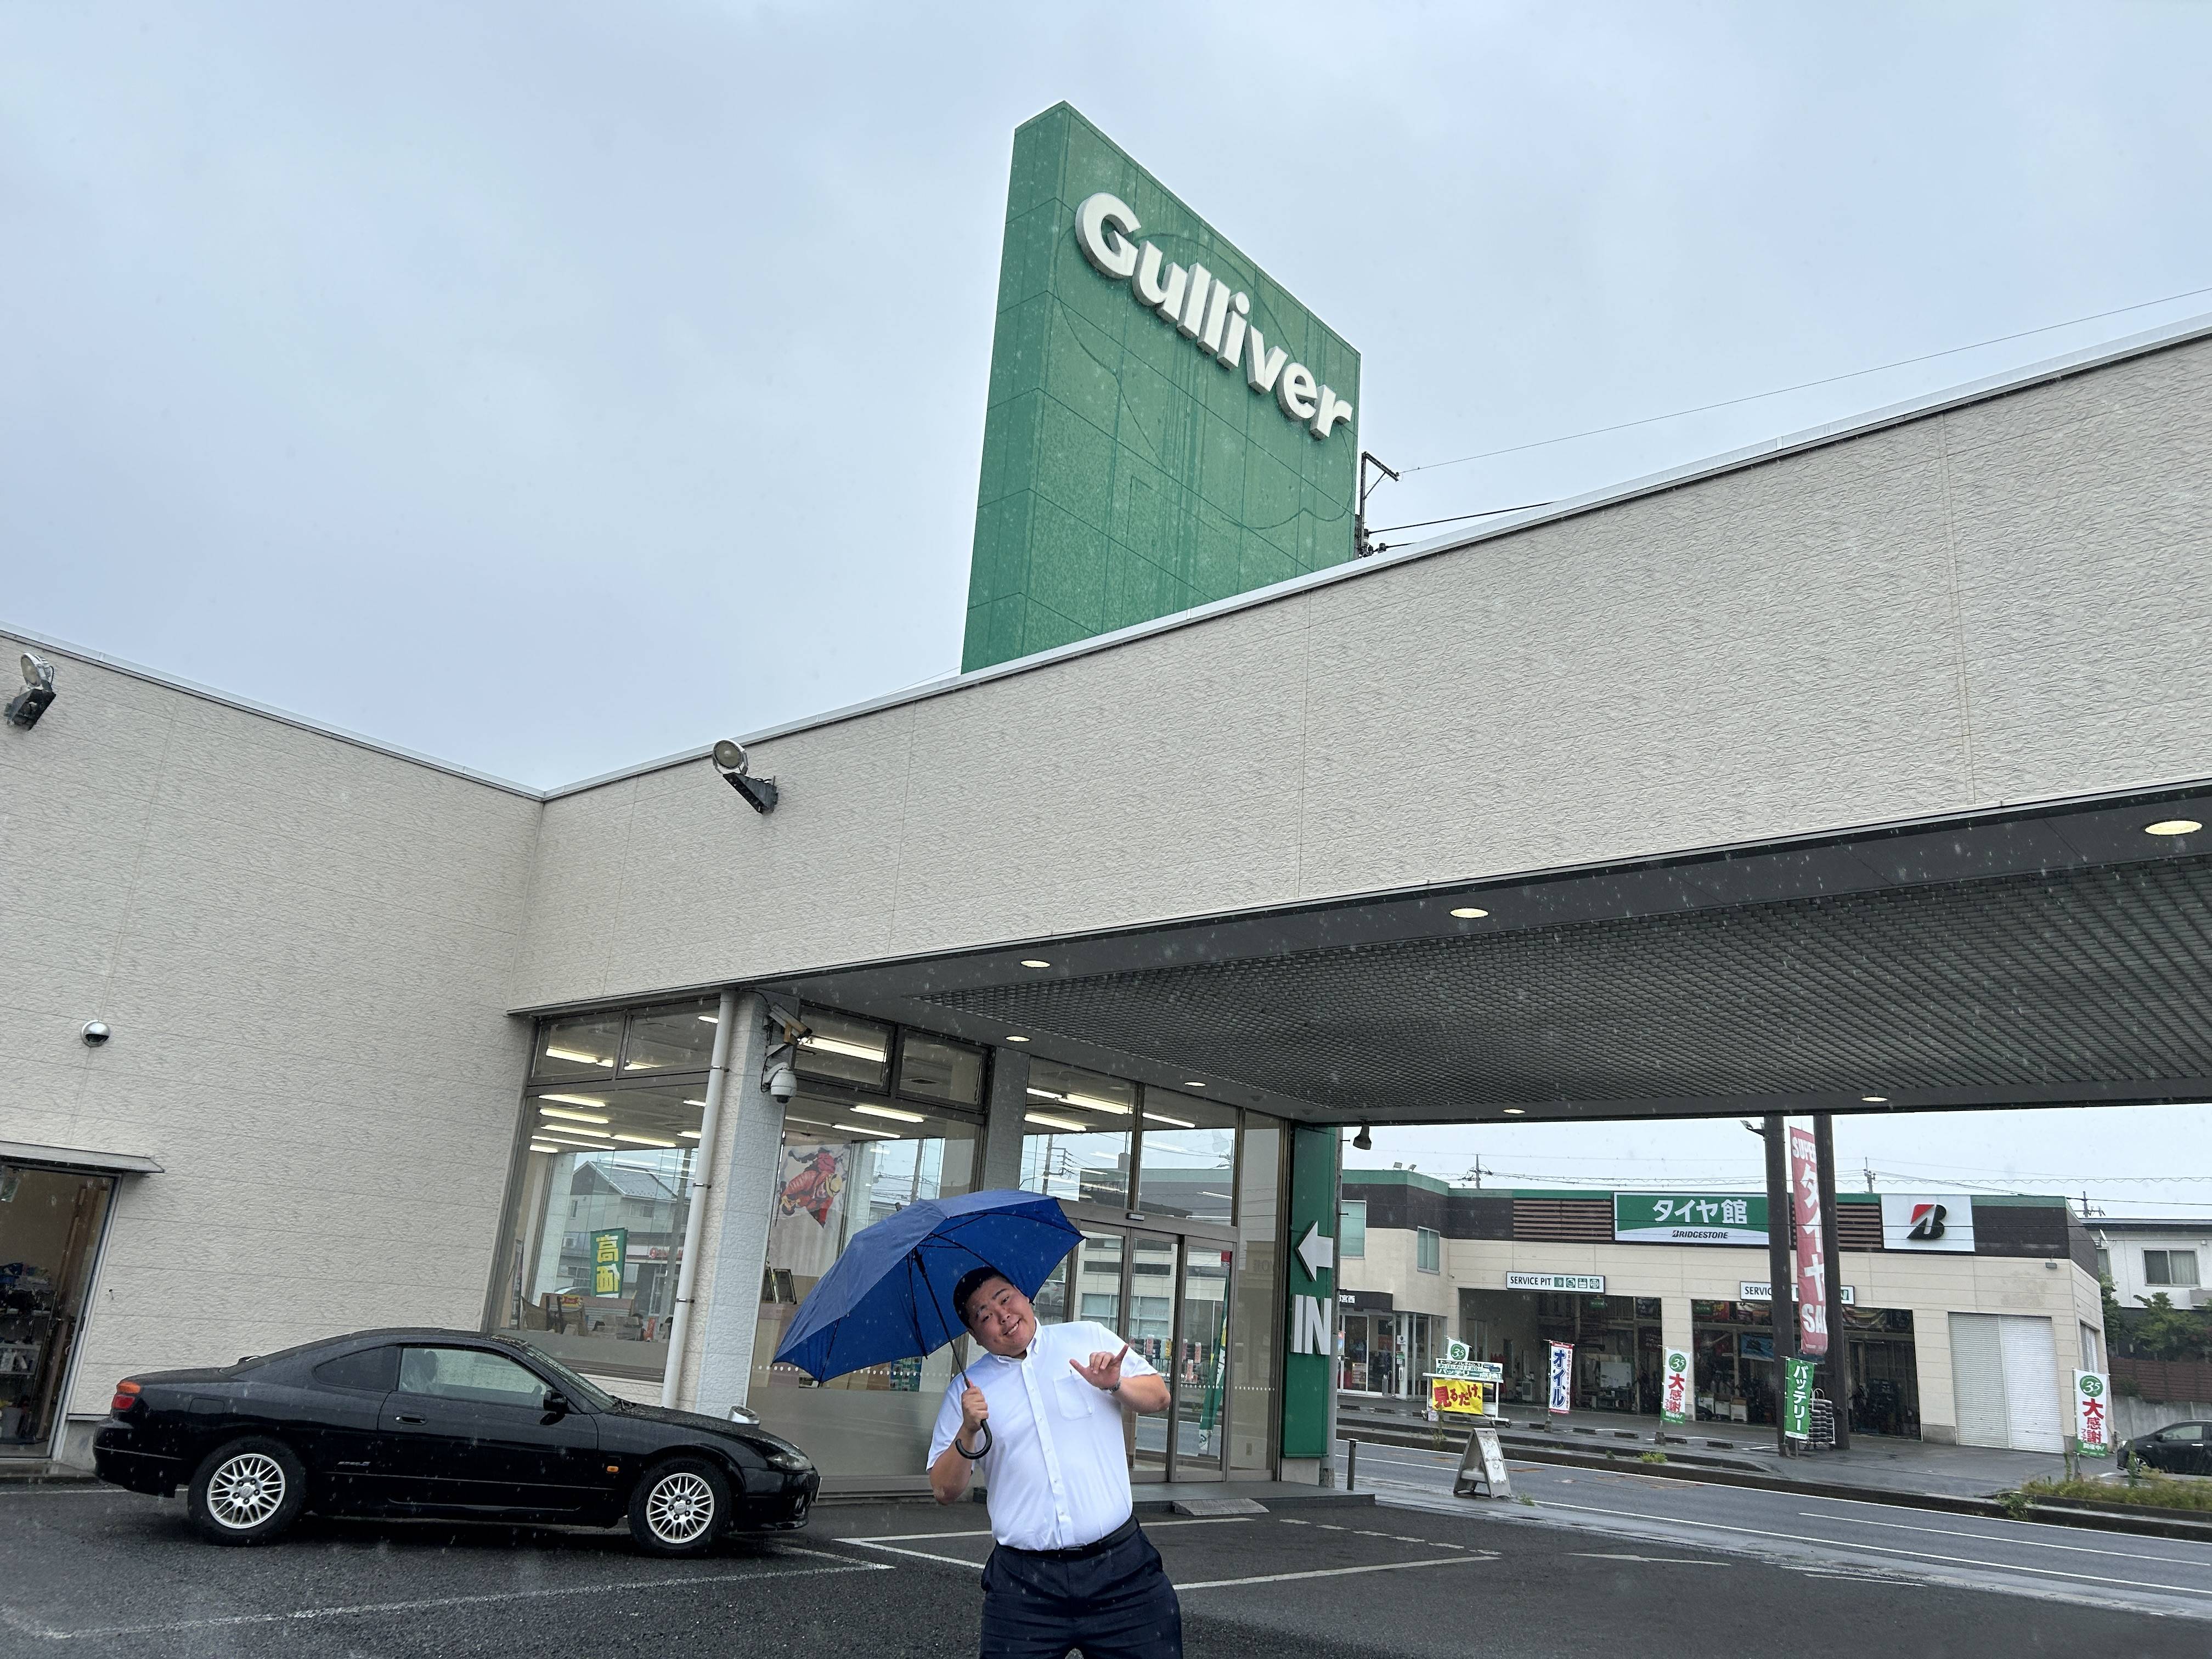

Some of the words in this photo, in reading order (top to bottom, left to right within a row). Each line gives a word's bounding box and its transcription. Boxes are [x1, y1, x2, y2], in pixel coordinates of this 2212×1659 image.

[1075, 192, 1353, 439] Gulliver
[1792, 1136, 1816, 1163] SUPE
[1652, 1199, 1747, 1224] タイヤ館
[1672, 1230, 1728, 1239] BRIDGESTONE
[1510, 1276, 1538, 1285] SERVICE
[1541, 1278, 1551, 1286] PIT
[1745, 1286, 1772, 1296] SERVIC
[1290, 1294, 1331, 1355] IN
[1553, 1349, 1566, 1407] オイル
[1793, 1365, 1809, 1431] バッテリー
